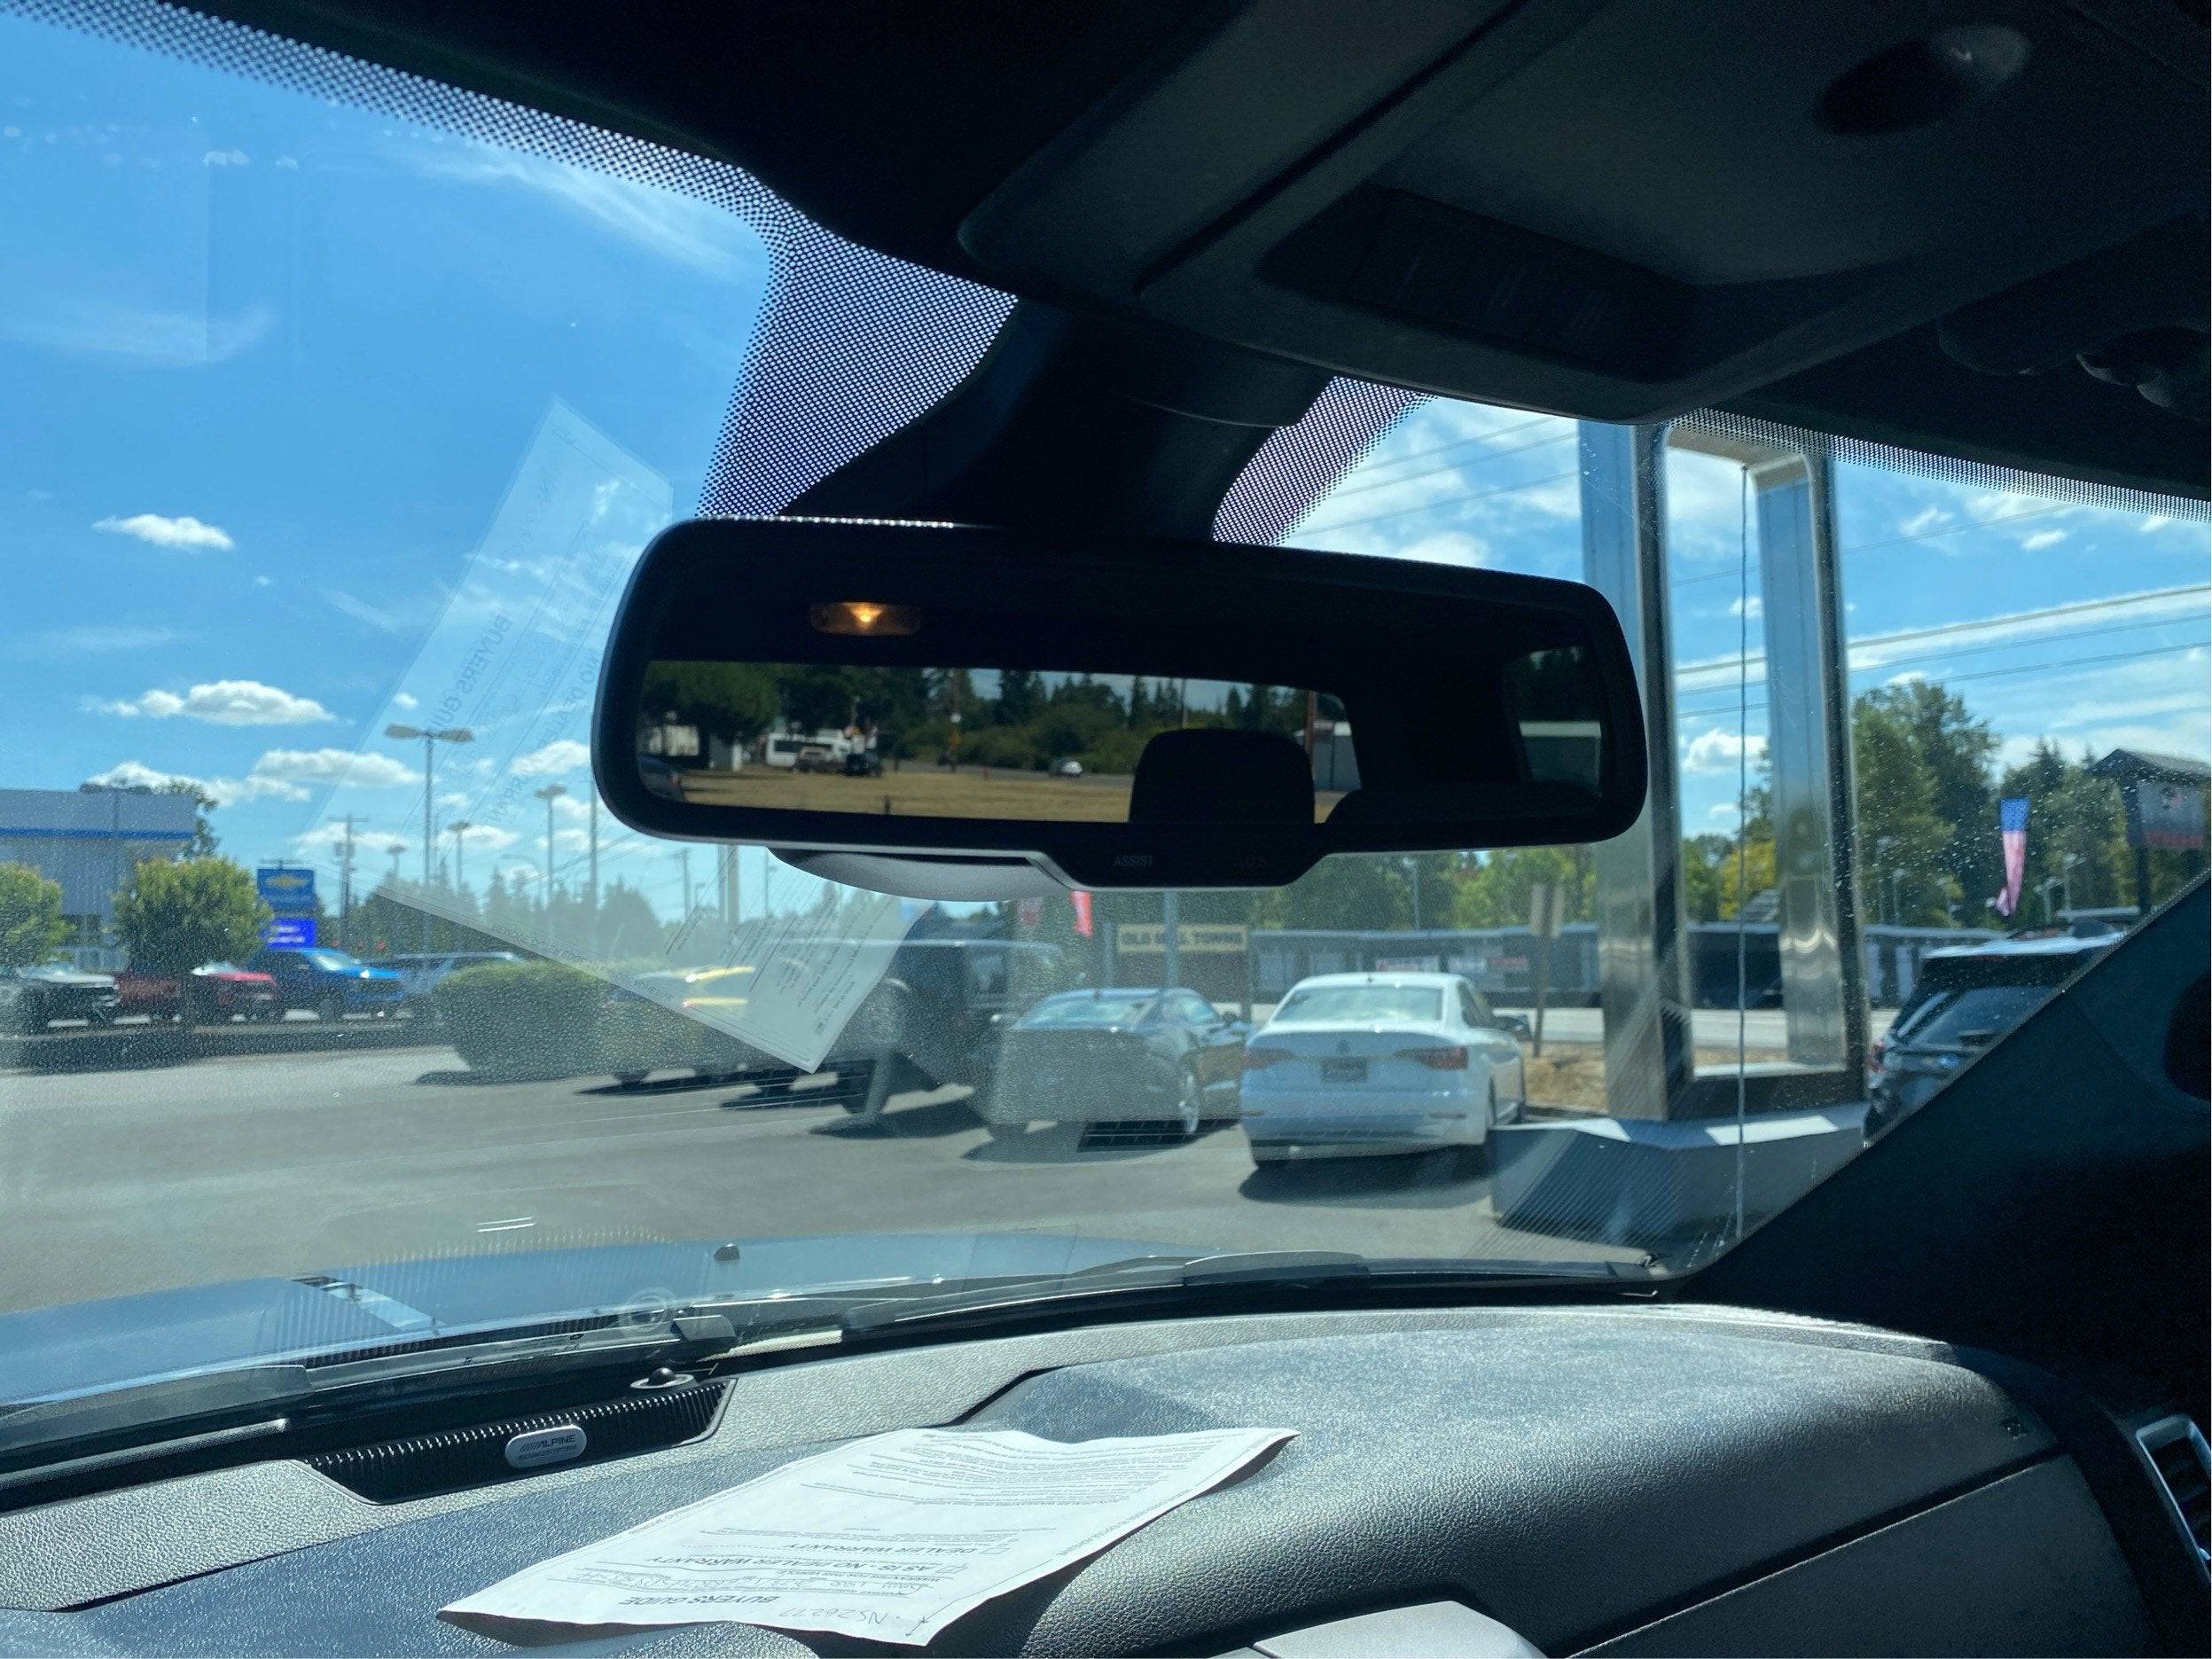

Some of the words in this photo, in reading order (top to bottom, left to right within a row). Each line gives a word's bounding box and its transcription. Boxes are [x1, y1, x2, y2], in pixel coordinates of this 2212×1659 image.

[1114, 855, 1153, 868] ASSIST
[535, 1435, 576, 1451] ALPINE
[780, 1543, 894, 1553] WARRANTY
[645, 1555, 753, 1566] WARRANTY
[754, 1558, 831, 1568] DEALER
[619, 1597, 688, 1606] GUIDE
[688, 1595, 780, 1604] BUYERS
